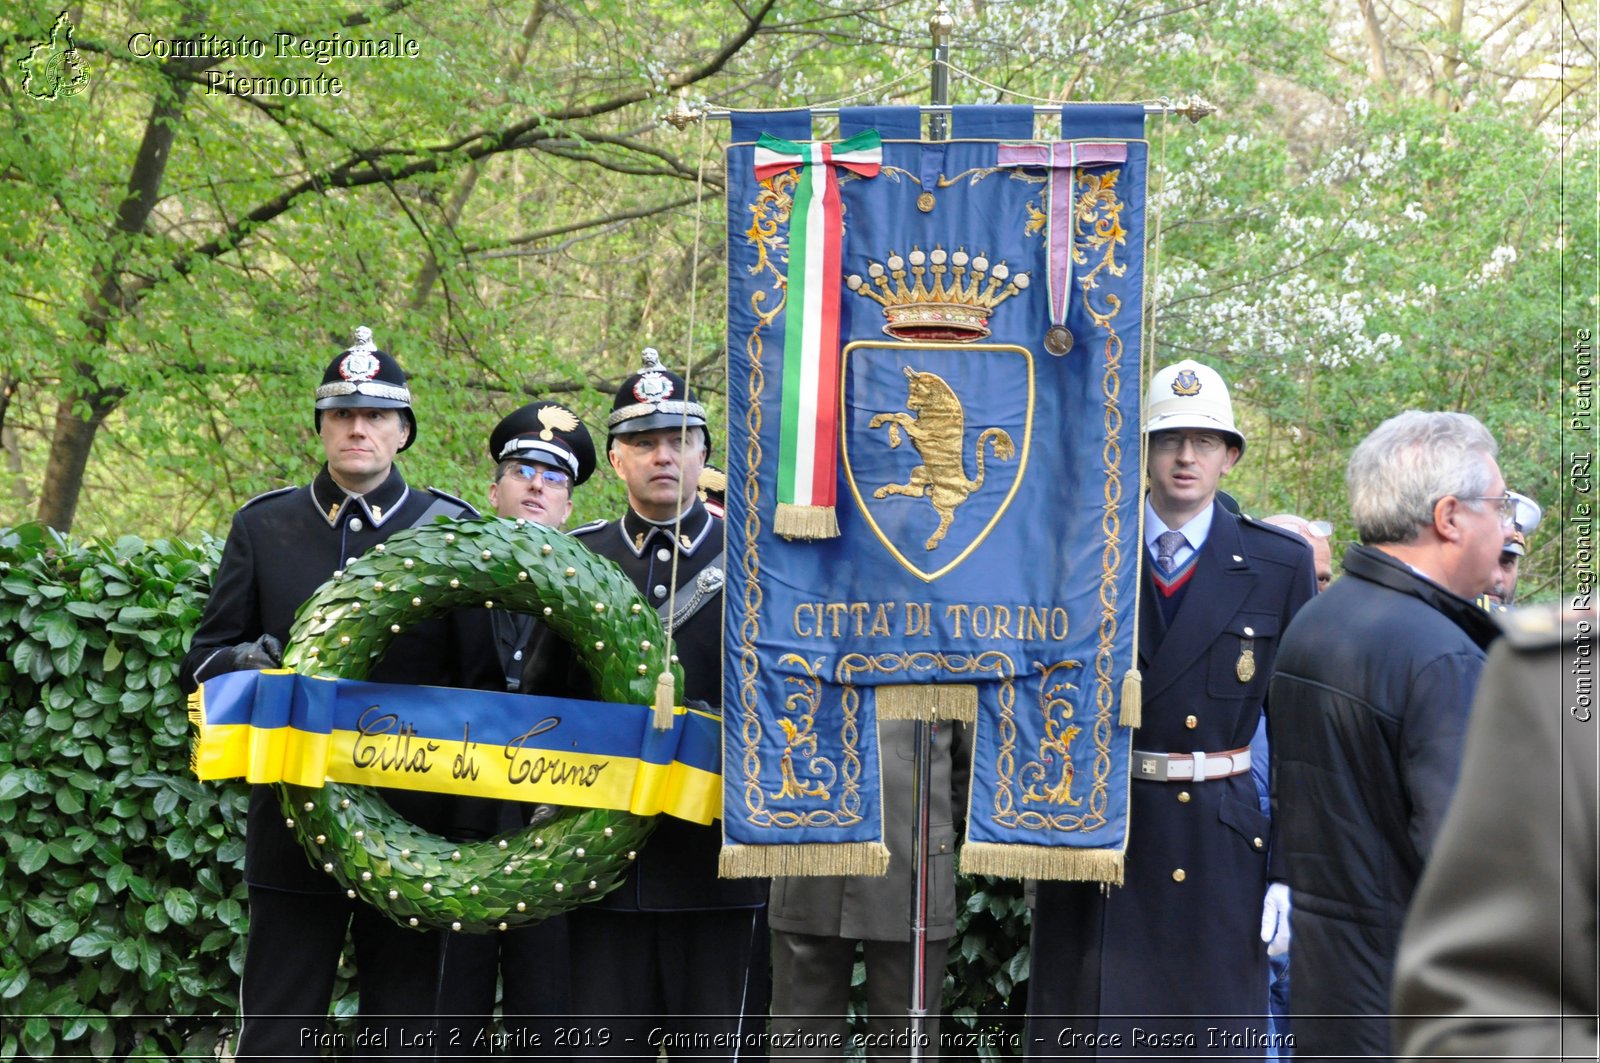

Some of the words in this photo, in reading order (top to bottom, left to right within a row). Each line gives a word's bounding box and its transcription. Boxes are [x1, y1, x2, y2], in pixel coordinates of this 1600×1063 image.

[904, 602, 932, 637] DI
[945, 604, 1069, 641] TORINO
[452, 721, 480, 781] di
[504, 714, 609, 787] Torino
